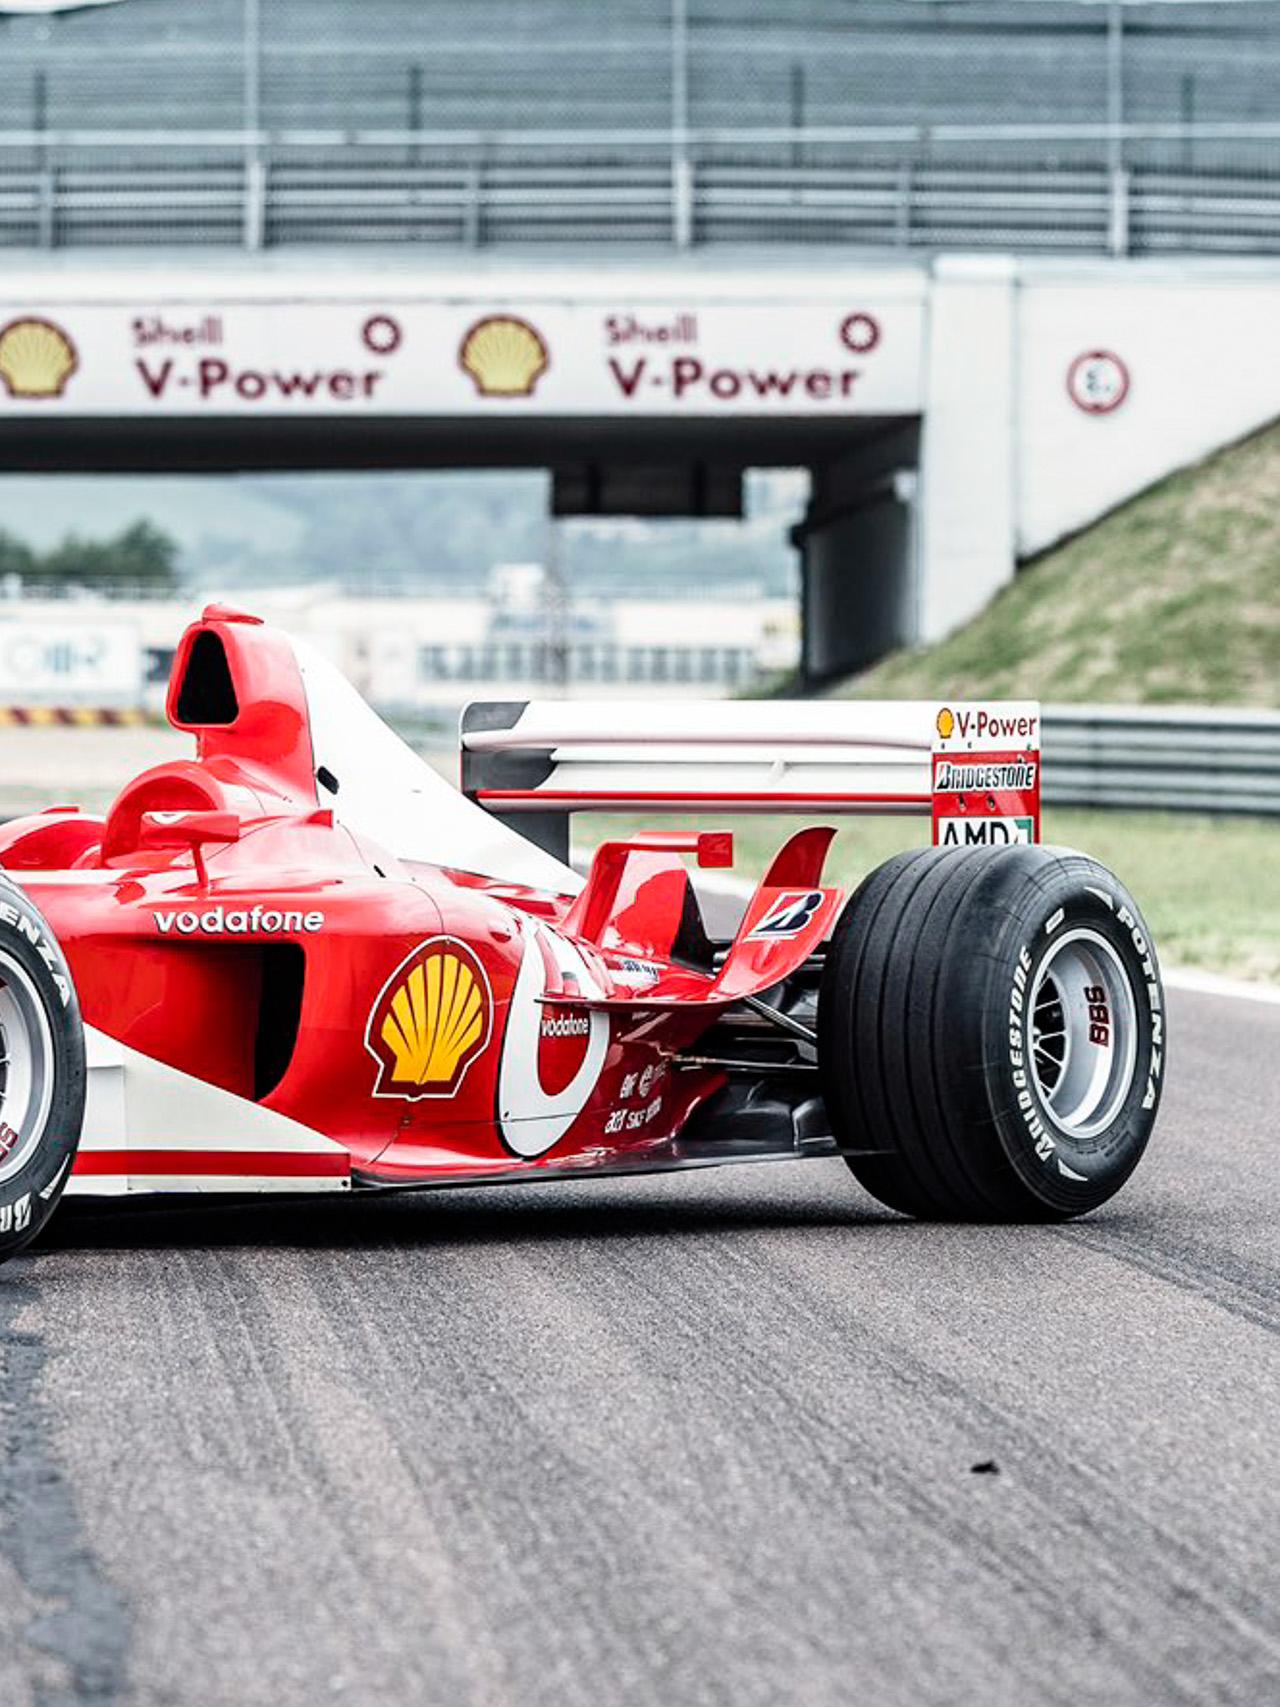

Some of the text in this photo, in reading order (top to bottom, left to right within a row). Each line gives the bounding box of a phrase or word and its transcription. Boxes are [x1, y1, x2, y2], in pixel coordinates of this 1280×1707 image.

[131, 317, 220, 347] Shell
[604, 315, 695, 345] Shell
[134, 358, 382, 402] V-Power
[607, 357, 860, 401] V-Power
[956, 711, 1037, 738] V-Power
[937, 763, 1034, 790] BRIDGESTONE
[944, 821, 1010, 845] AMD
[154, 905, 325, 933] vodafone
[1116, 905, 1163, 1110] POTENZA
[540, 1013, 590, 1037] vodafone
[1009, 944, 1057, 1162] BRIDGESTONE
